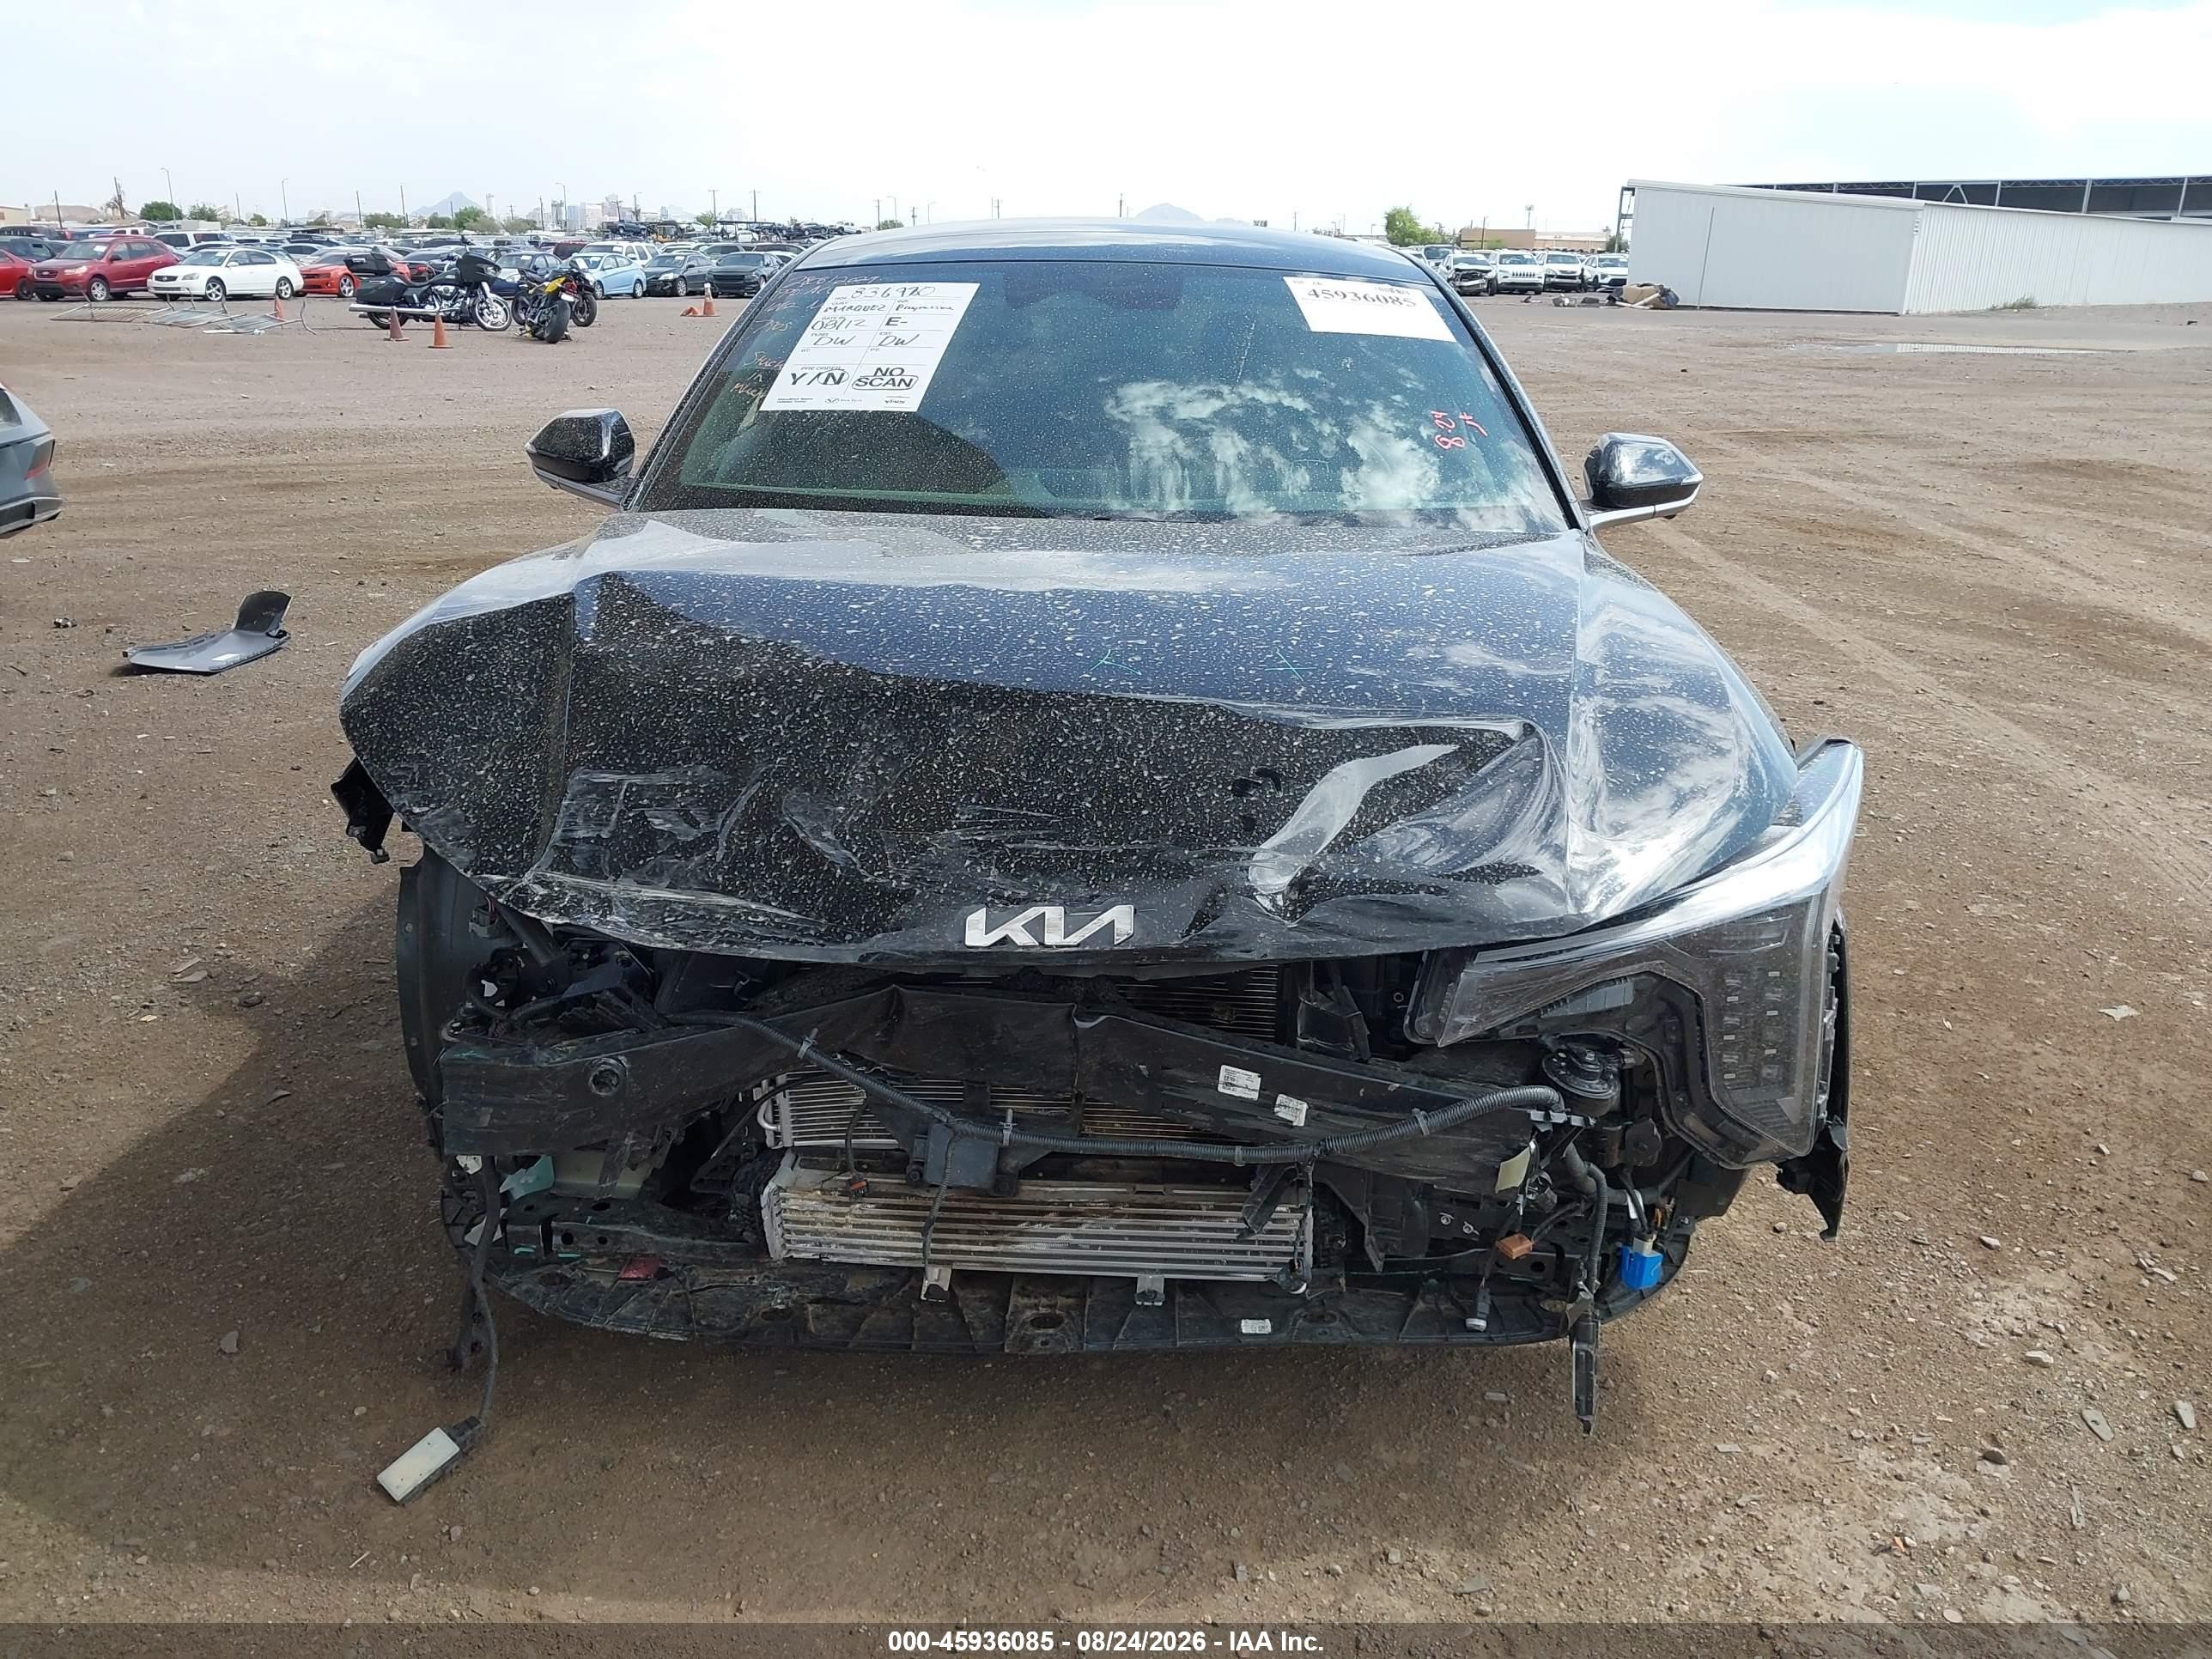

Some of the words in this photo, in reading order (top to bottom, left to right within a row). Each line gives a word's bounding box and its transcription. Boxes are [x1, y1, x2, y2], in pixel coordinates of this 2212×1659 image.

[1307, 289, 1417, 307] 45936085
[823, 304, 886, 313] MARQUEZ
[811, 319, 866, 331] 08/12
[873, 368, 905, 377] NO
[855, 377, 914, 387] SCAN
